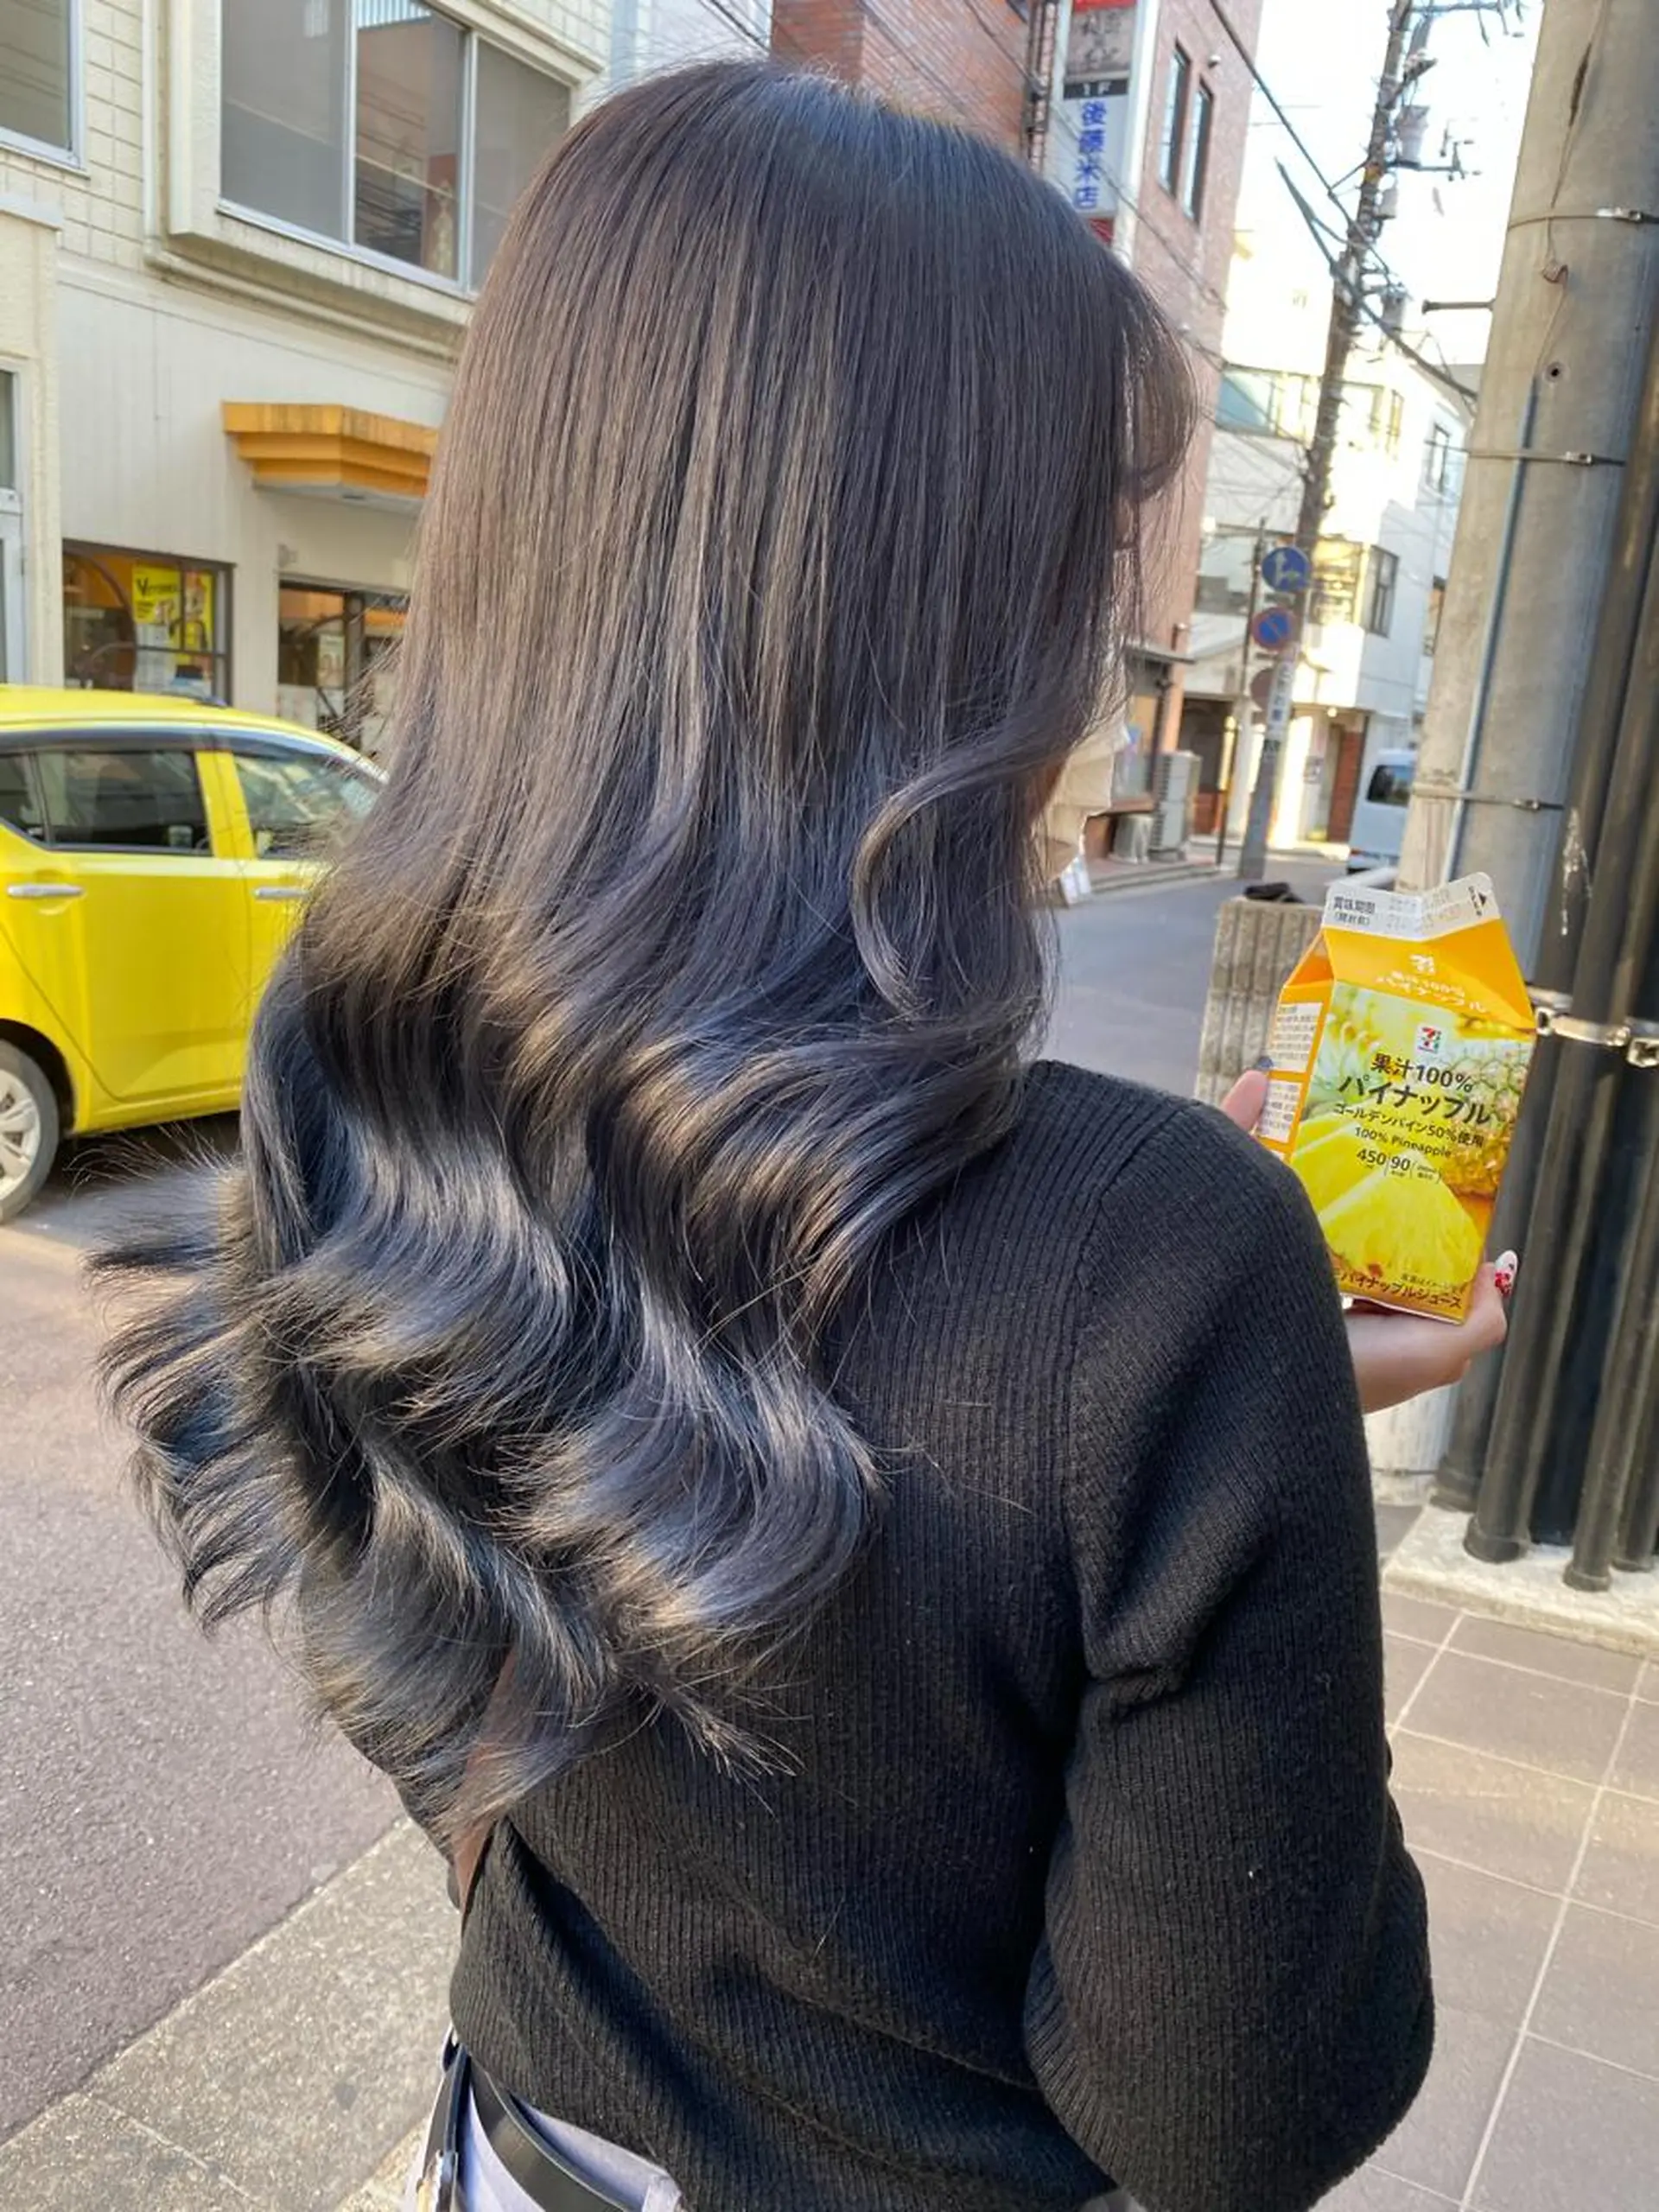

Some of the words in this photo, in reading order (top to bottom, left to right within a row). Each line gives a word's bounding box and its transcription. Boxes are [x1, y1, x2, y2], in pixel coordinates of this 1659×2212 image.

[1370, 1052, 1473, 1093] 果汁100%
[1357, 1148, 1387, 1166] 450
[1390, 1156, 1411, 1171] 90
